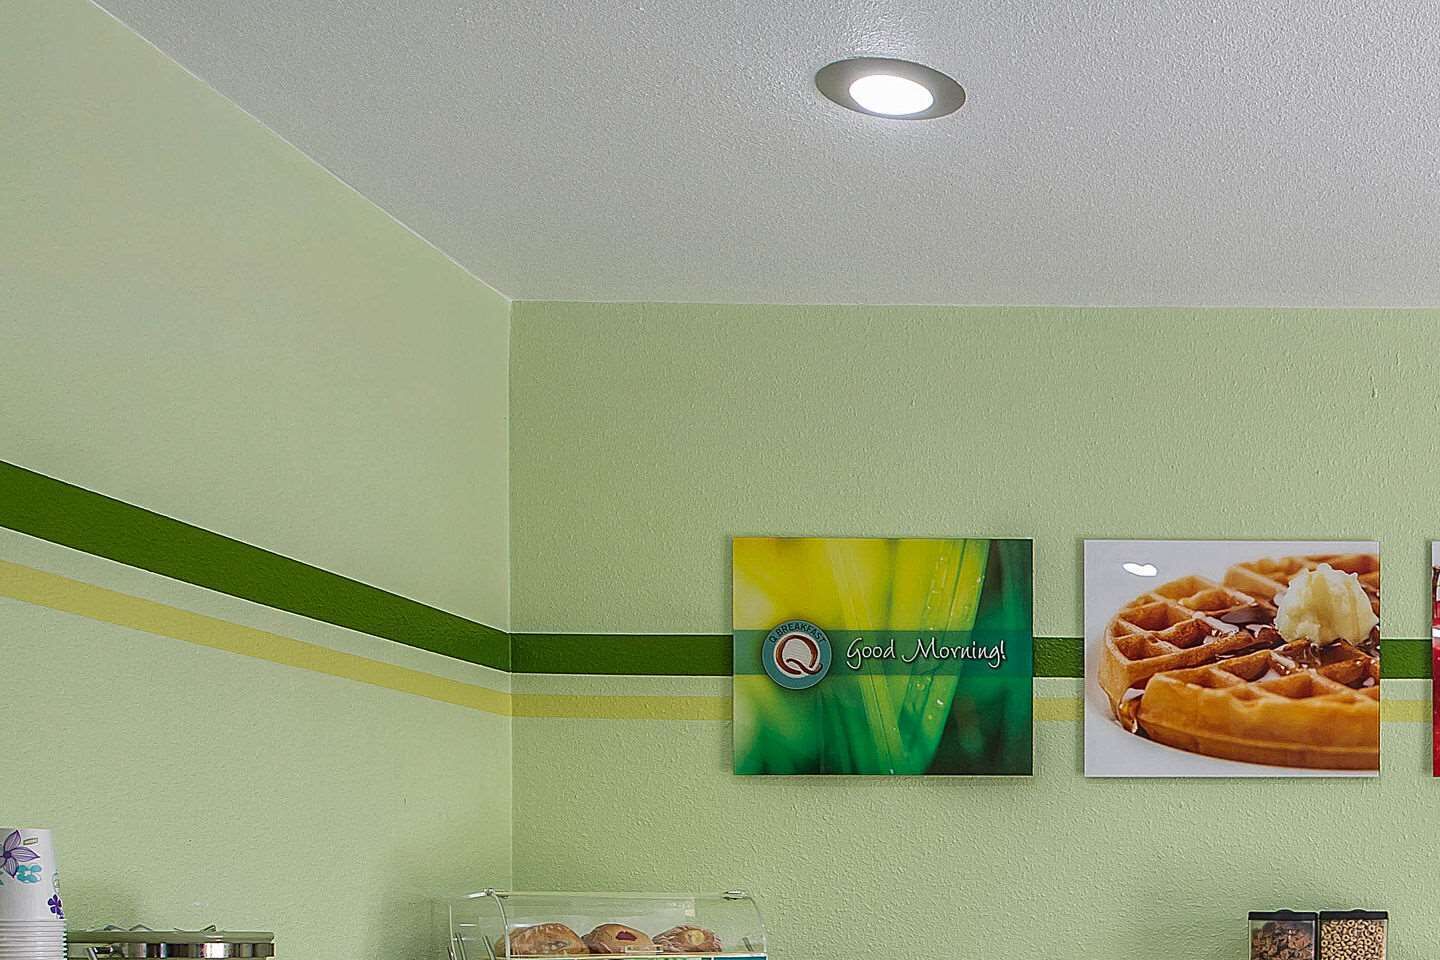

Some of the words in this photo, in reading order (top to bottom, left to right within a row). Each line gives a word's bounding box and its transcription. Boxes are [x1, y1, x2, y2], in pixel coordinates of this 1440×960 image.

[775, 622, 827, 642] BREAKFAST
[774, 634, 823, 675] Q
[846, 637, 896, 670] Good
[901, 637, 1006, 668] Morning!
